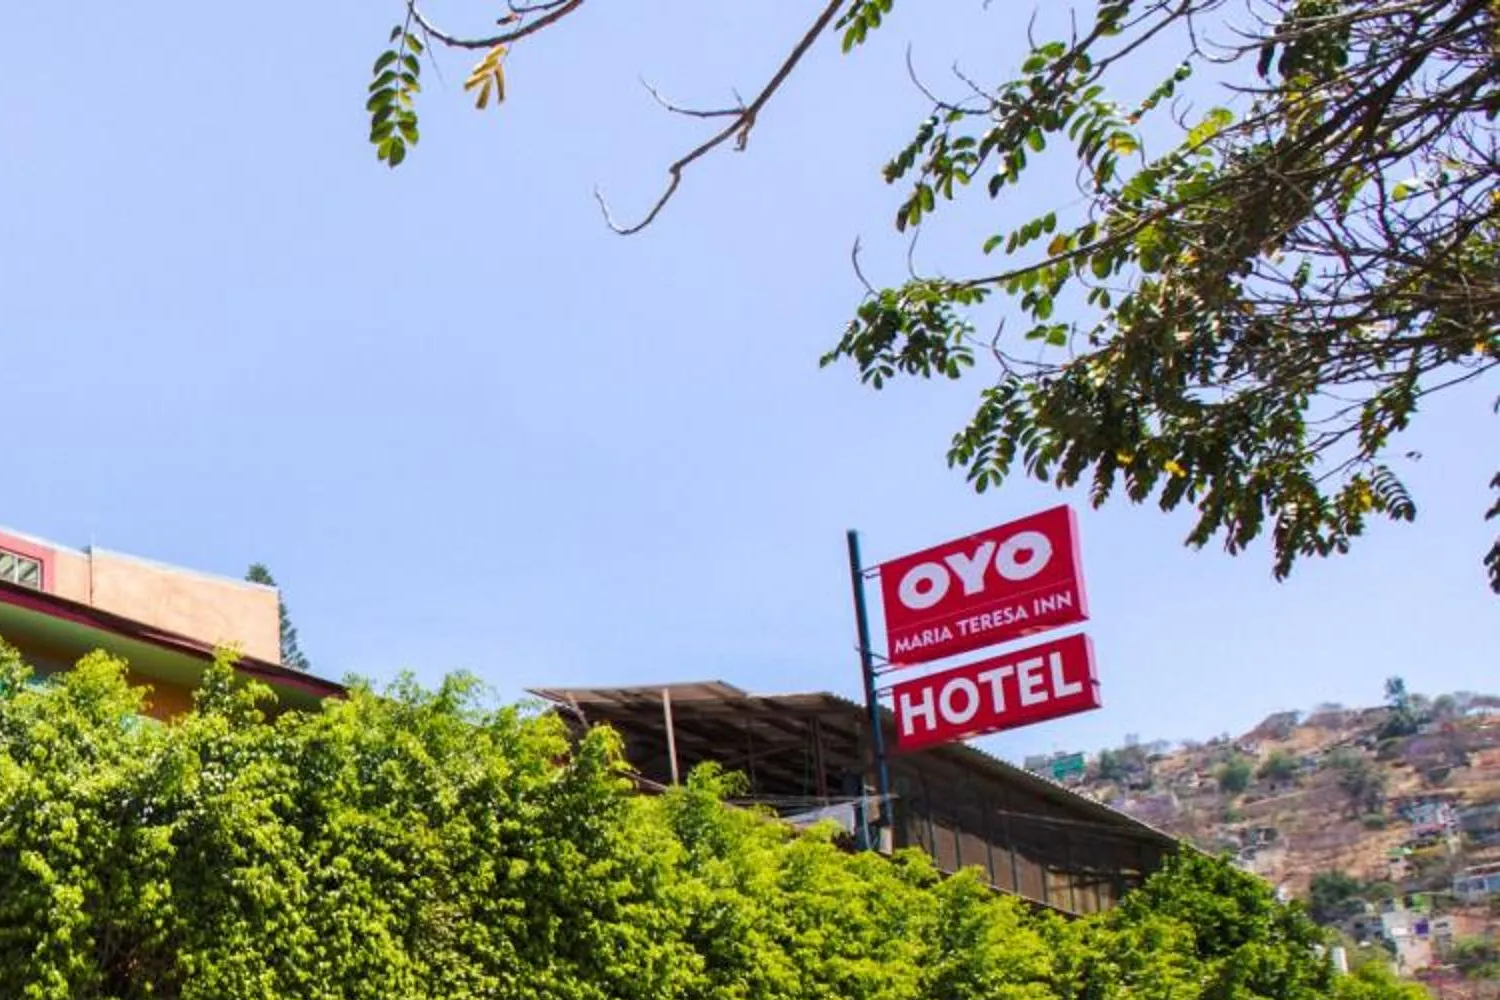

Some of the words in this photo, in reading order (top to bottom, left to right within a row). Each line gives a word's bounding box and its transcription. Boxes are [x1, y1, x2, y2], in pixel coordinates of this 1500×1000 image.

[898, 531, 1052, 610] OYO
[894, 625, 953, 654] MARIA
[956, 604, 1029, 636] TERESA
[1033, 591, 1073, 617] INN
[900, 651, 1083, 736] HOTEL
